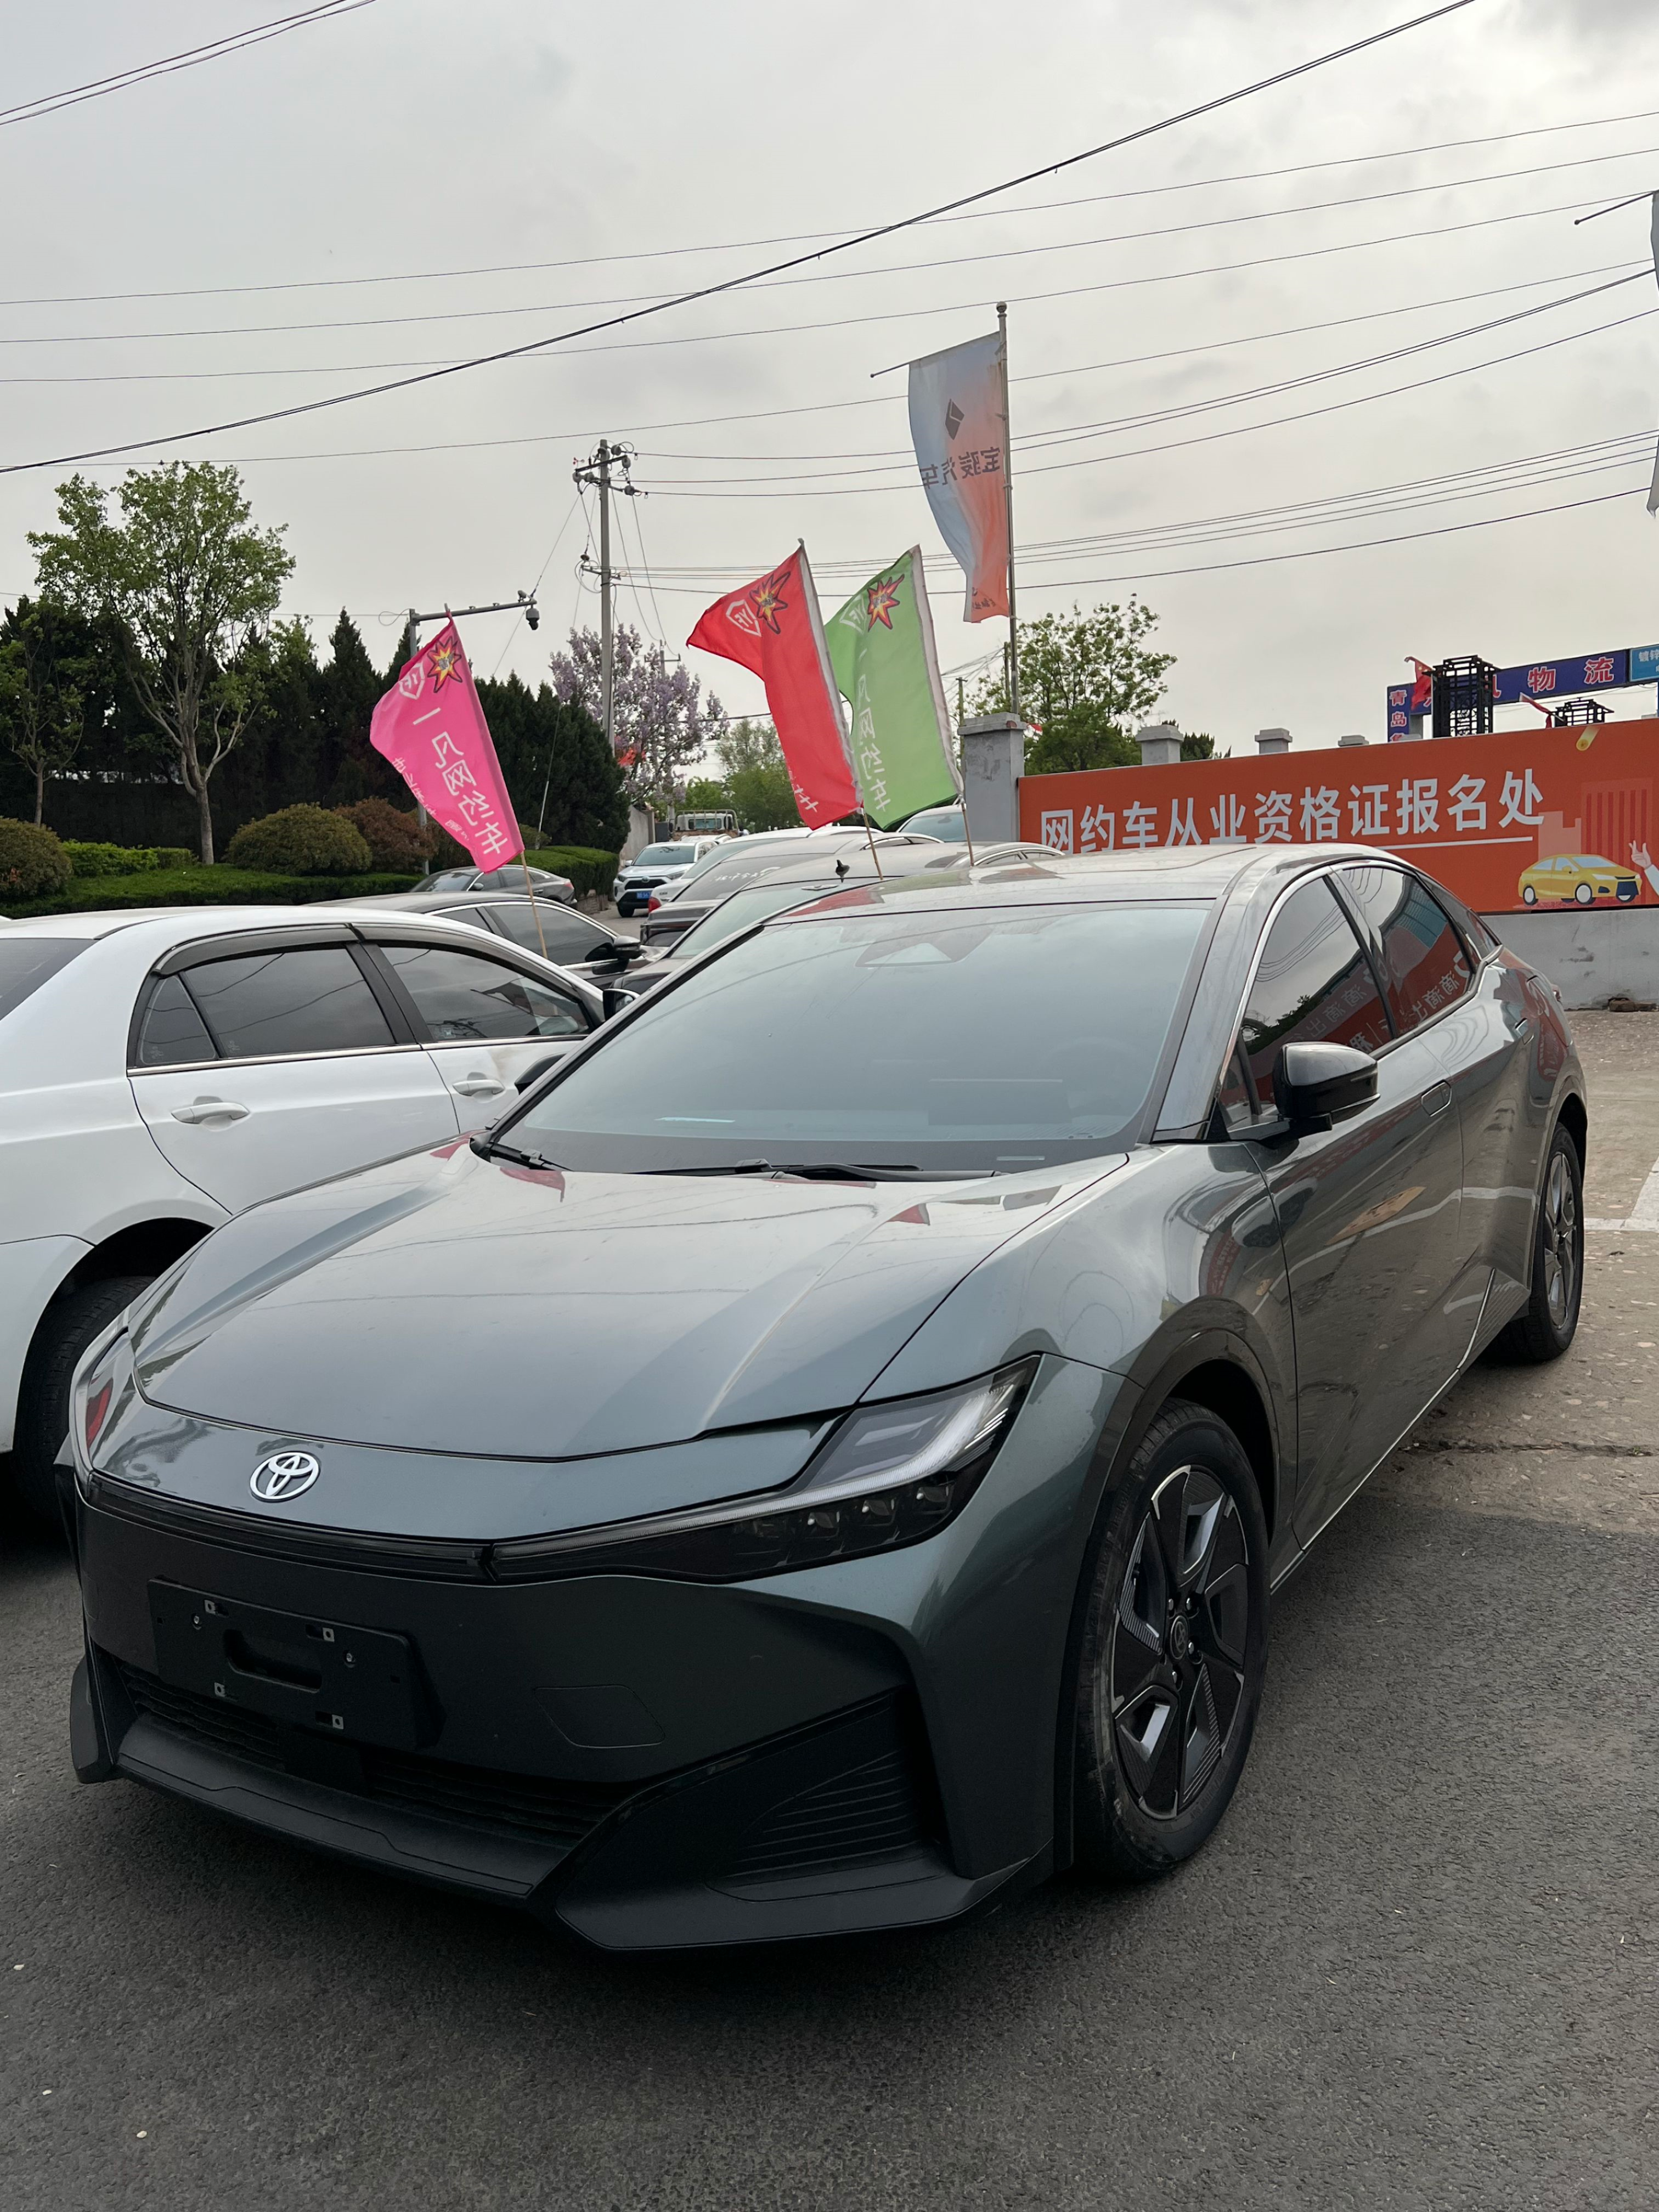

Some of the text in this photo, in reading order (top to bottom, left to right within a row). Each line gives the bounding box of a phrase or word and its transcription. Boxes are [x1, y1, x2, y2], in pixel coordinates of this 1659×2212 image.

[1041, 769, 1544, 854] 网约车从业资格证报名处
